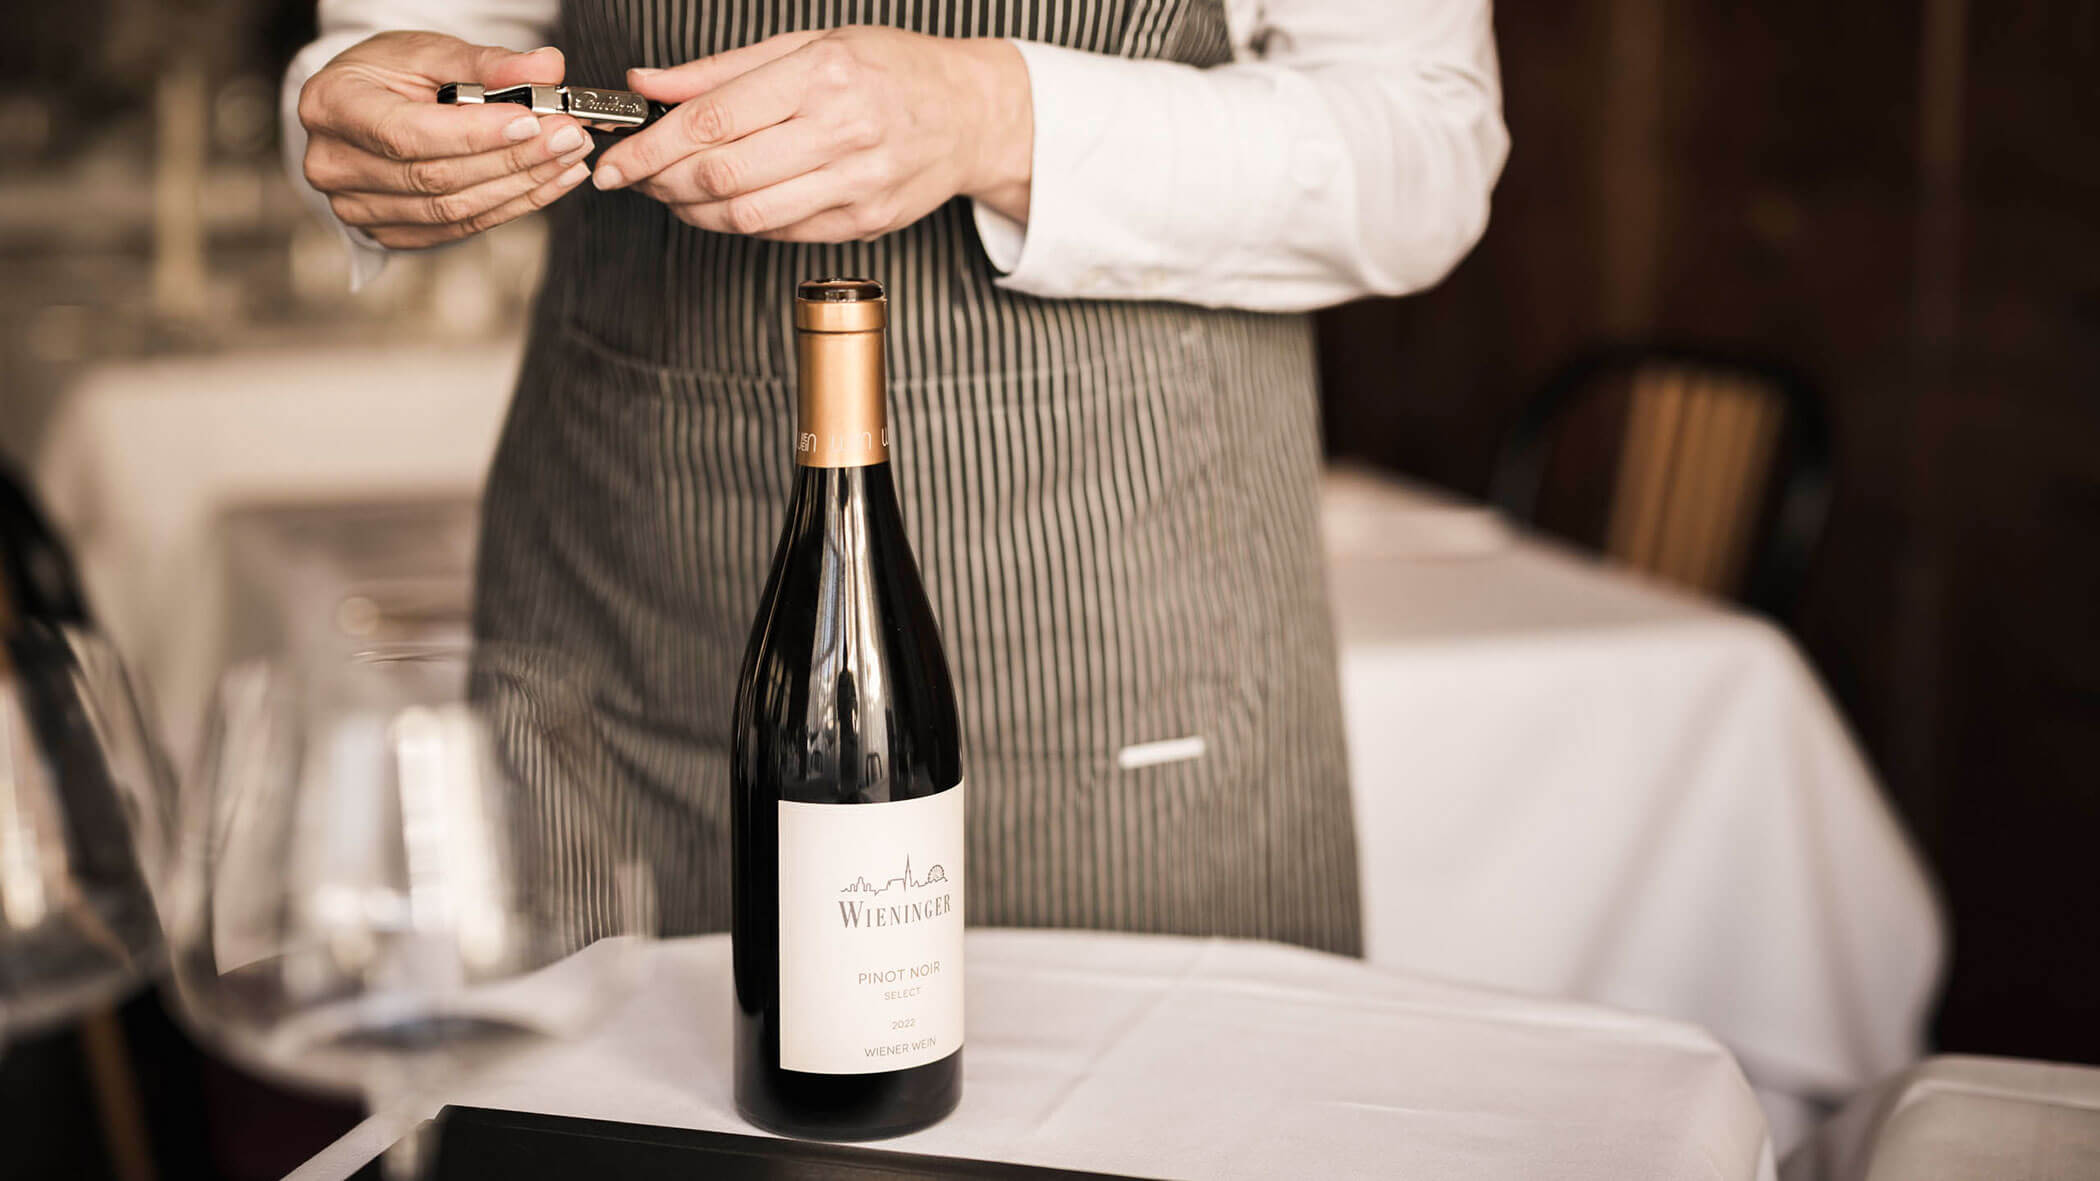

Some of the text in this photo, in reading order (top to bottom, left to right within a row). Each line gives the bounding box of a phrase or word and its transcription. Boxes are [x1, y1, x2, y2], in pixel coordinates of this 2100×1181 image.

[838, 894, 951, 928] WIENINGER
[858, 960, 941, 985] PINOT NOIR
[884, 987, 921, 1001] SELECT
[892, 1018, 916, 1030] 2022
[864, 1037, 937, 1057] WIENER WEIN
